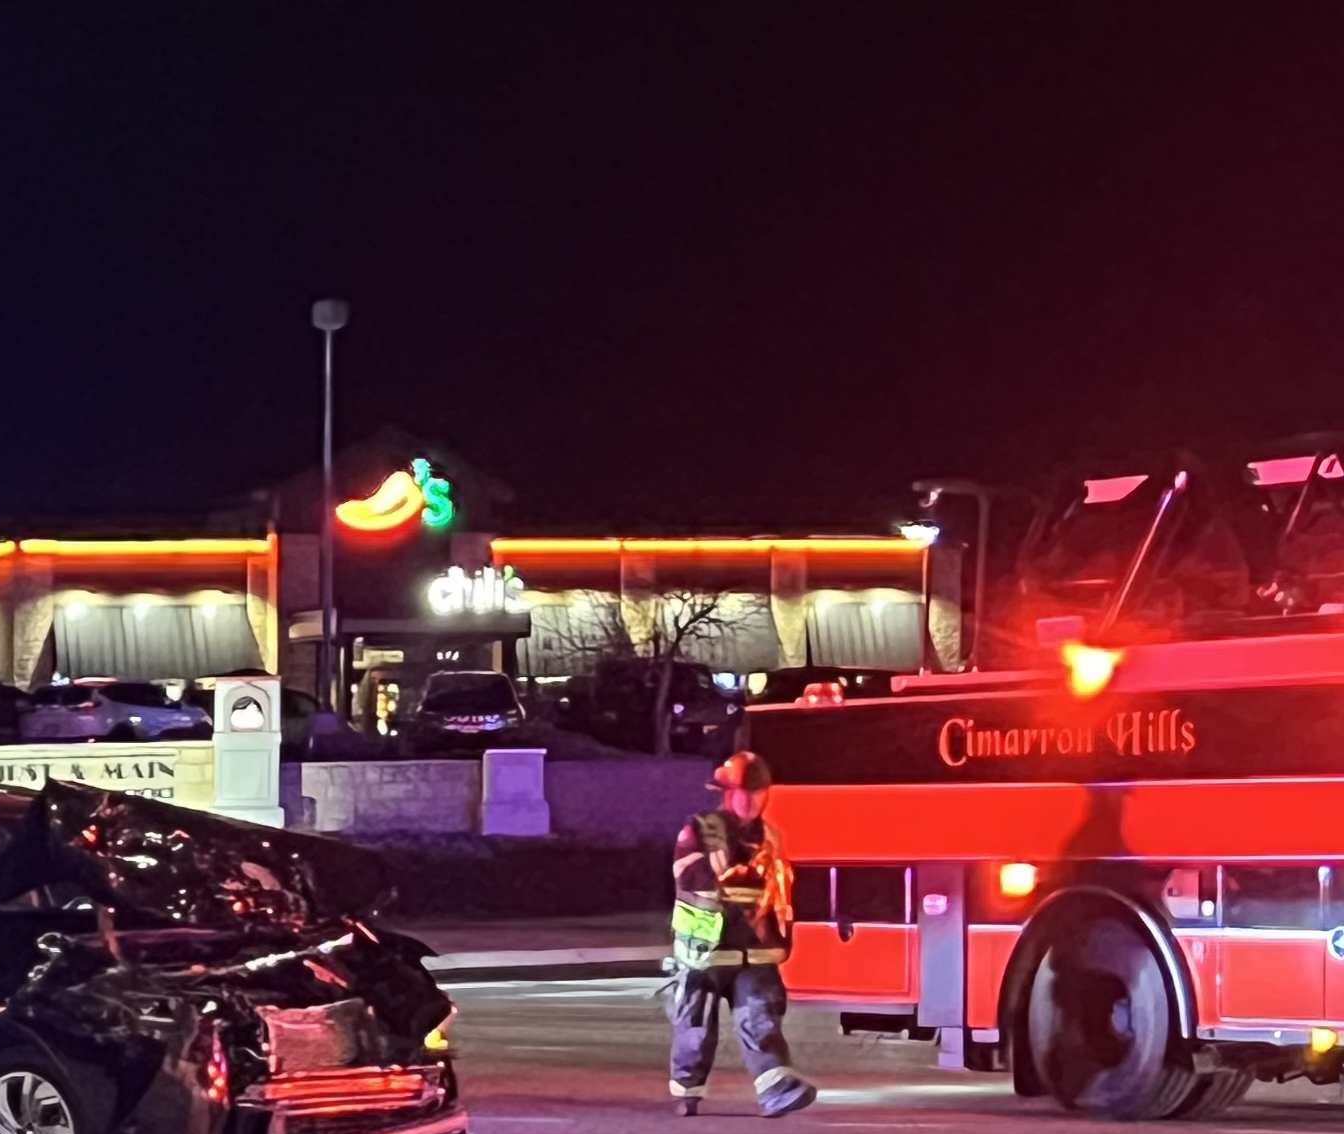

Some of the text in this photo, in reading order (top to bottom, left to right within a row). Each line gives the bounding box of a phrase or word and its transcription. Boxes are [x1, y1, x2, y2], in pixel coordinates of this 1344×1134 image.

[939, 708, 1196, 766] Cimarron Hills
[100, 761, 174, 780] MAIN
